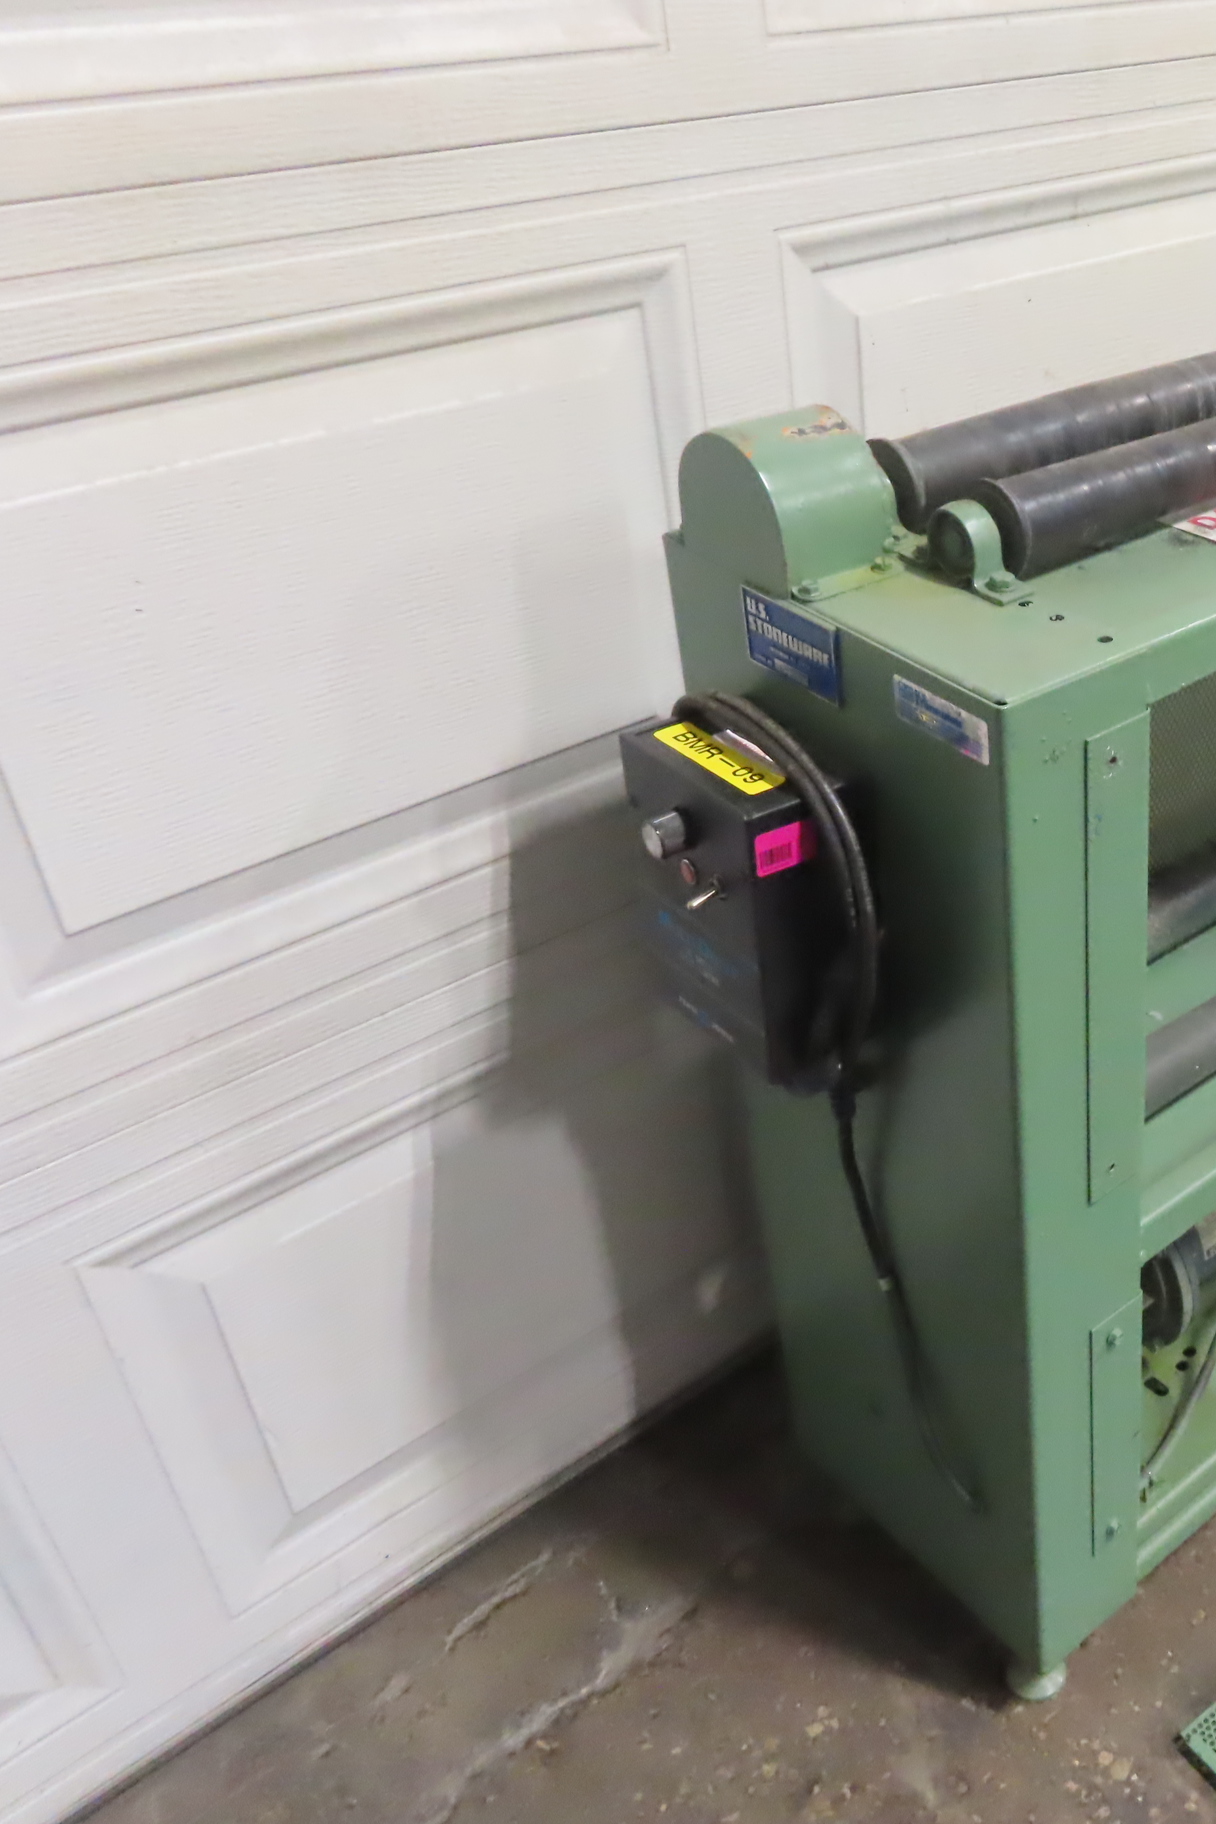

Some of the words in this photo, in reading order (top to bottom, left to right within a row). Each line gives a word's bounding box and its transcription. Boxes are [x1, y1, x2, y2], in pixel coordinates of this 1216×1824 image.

[746, 596, 769, 620] U.S.
[748, 615, 830, 667] STONEWARE
[672, 730, 765, 784] BMR-09
